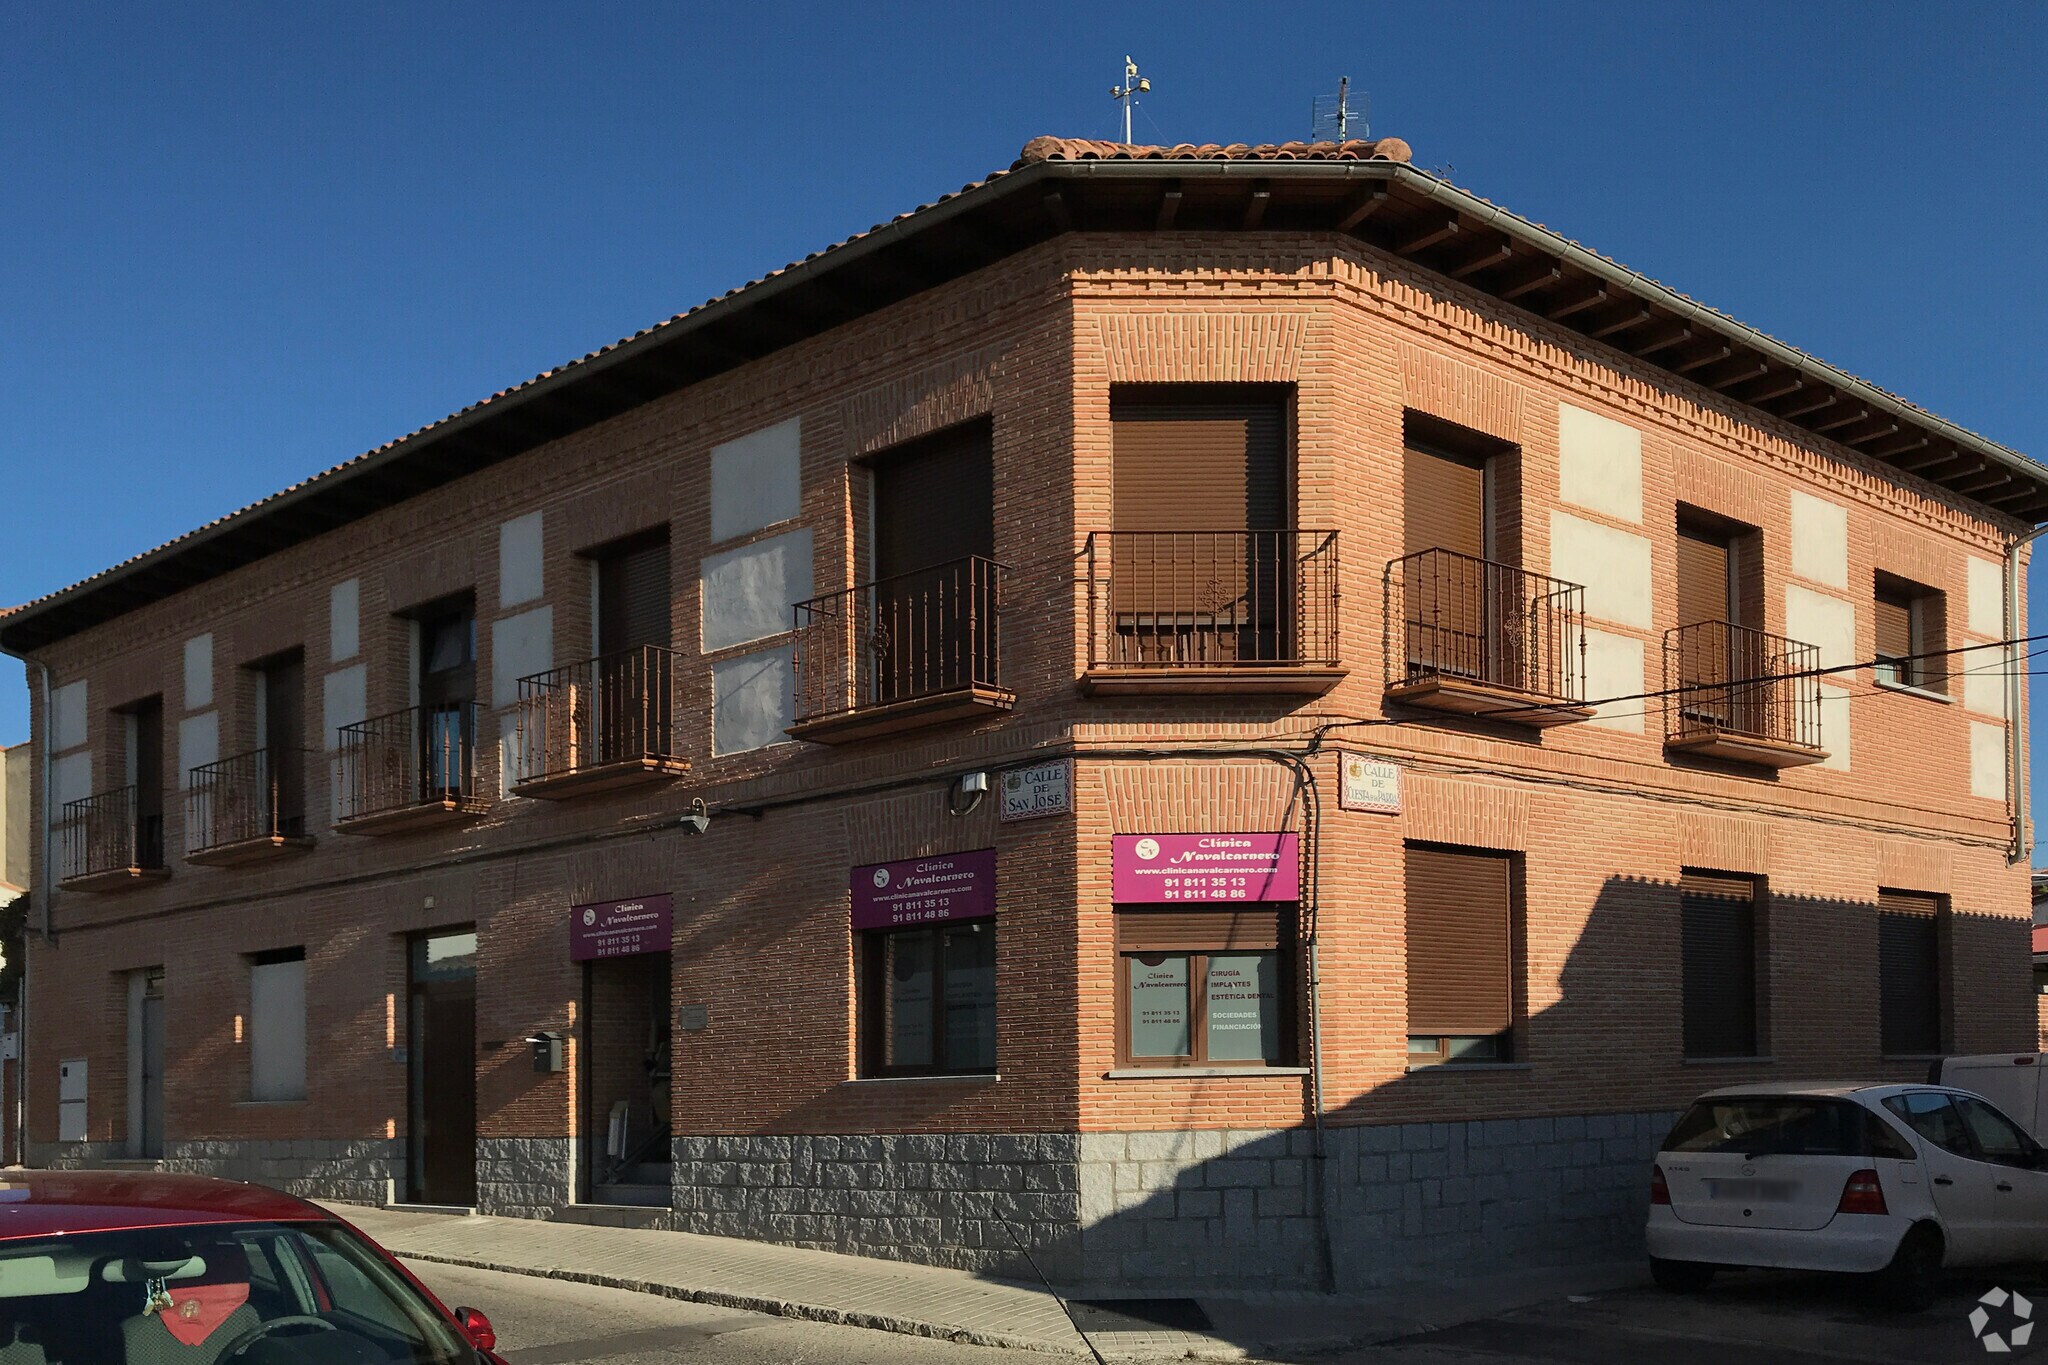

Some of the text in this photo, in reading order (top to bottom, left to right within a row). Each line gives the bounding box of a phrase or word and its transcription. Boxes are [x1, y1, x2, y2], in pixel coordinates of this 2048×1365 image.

[1024, 769, 1062, 784] CALLE
[1364, 764, 1394, 779] CALLE
[1034, 784, 1050, 794] DE
[1372, 780, 1384, 788] DE
[1008, 792, 1062, 812] SAN JOSÉ
[1198, 838, 1251, 848] Clínica
[1170, 851, 1280, 863] Navalcarnero
[916, 861, 953, 873] Clínica
[896, 872, 974, 889] Navalcarnero
[1164, 878, 1246, 887] 91 811 35 13
[873, 885, 972, 902] www.clinicanavalcarnero.com
[1164, 890, 1246, 898] 91 811 48 86
[893, 898, 949, 912] 91 811 35 13
[600, 912, 659, 927] Navalcarnero
[893, 909, 949, 922] 91 811 48 86
[1211, 992, 1246, 1000] ESTÉTICA
